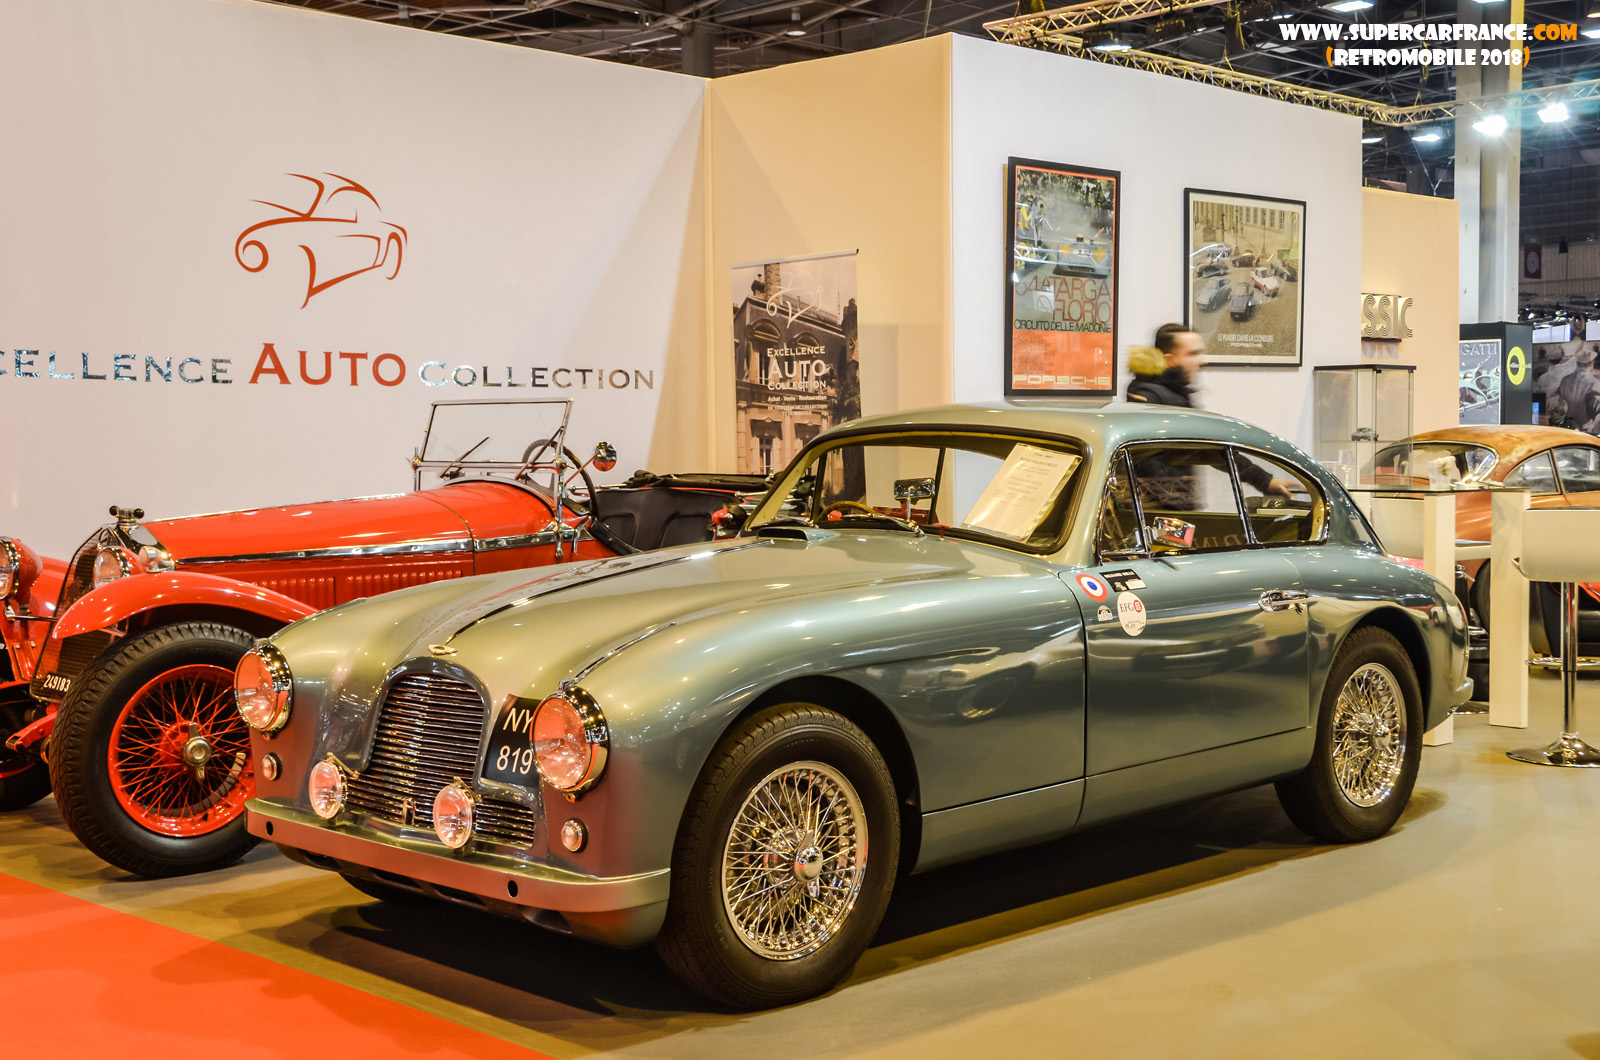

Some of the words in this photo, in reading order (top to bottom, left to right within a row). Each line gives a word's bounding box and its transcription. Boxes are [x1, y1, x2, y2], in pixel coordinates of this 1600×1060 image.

[1049, 276, 1112, 301] TARGA
[1053, 298, 1112, 324] FLORIO
[1362, 294, 1413, 338] SSIC
[1014, 319, 1050, 330] CIRCUITO
[1051, 322, 1074, 331] DELLE
[1076, 323, 1112, 333] MADONIE
[767, 346, 826, 357] EXCELLENCE
[0, 349, 233, 384] ELLENCE
[248, 342, 406, 387] AUTO
[417, 360, 655, 390] COLLECTION
[768, 360, 826, 379] AUTO
[768, 380, 826, 390] COLLECTION
[1013, 374, 1110, 385] PORSCHE
[44, 674, 71, 692] 249183
[496, 744, 533, 775] 819
